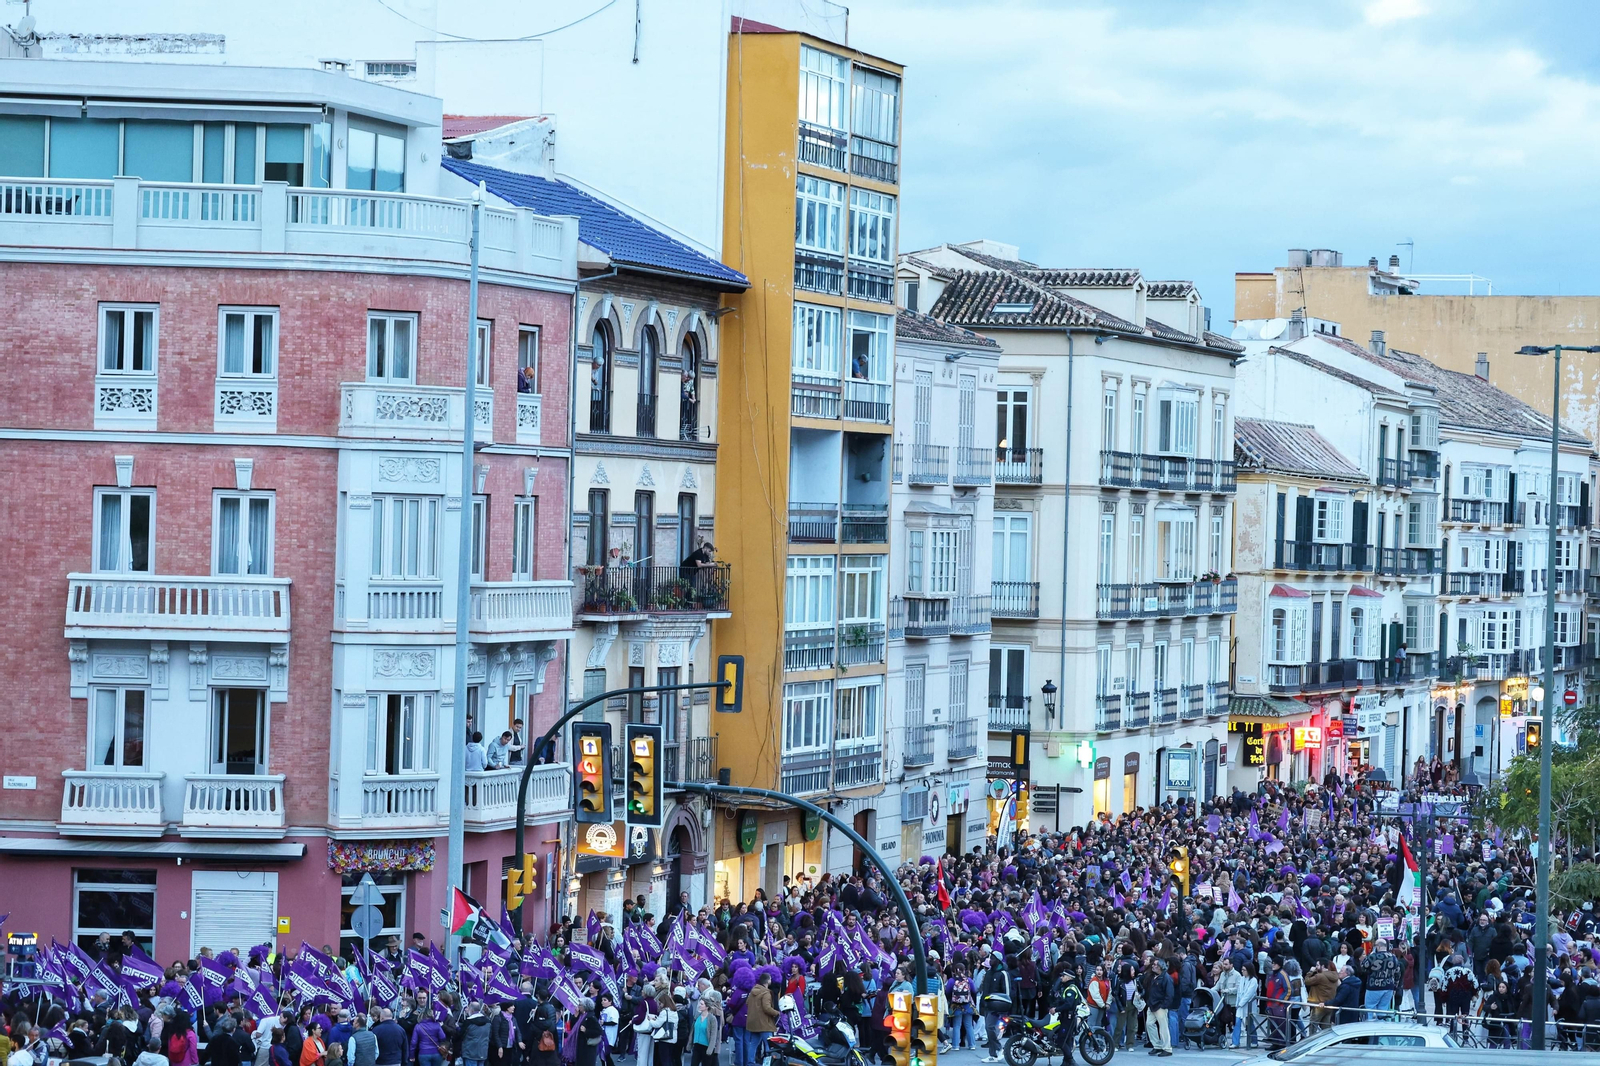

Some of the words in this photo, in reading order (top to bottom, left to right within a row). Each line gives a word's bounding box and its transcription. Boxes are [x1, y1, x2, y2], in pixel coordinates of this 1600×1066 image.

[987, 761, 1012, 769] armac
[925, 829, 945, 845] NONNA
[881, 841, 897, 851] HELADO
[8, 937, 23, 946] ATM
[23, 937, 37, 946] ATM
[581, 953, 600, 967] CCOO
[133, 970, 158, 985] CCOO
[206, 970, 226, 985] CCOO
[100, 975, 119, 997] CCOO
[296, 978, 317, 997] CCOO
[377, 980, 395, 1000] CCOO
[188, 986, 203, 1006] CCOO
